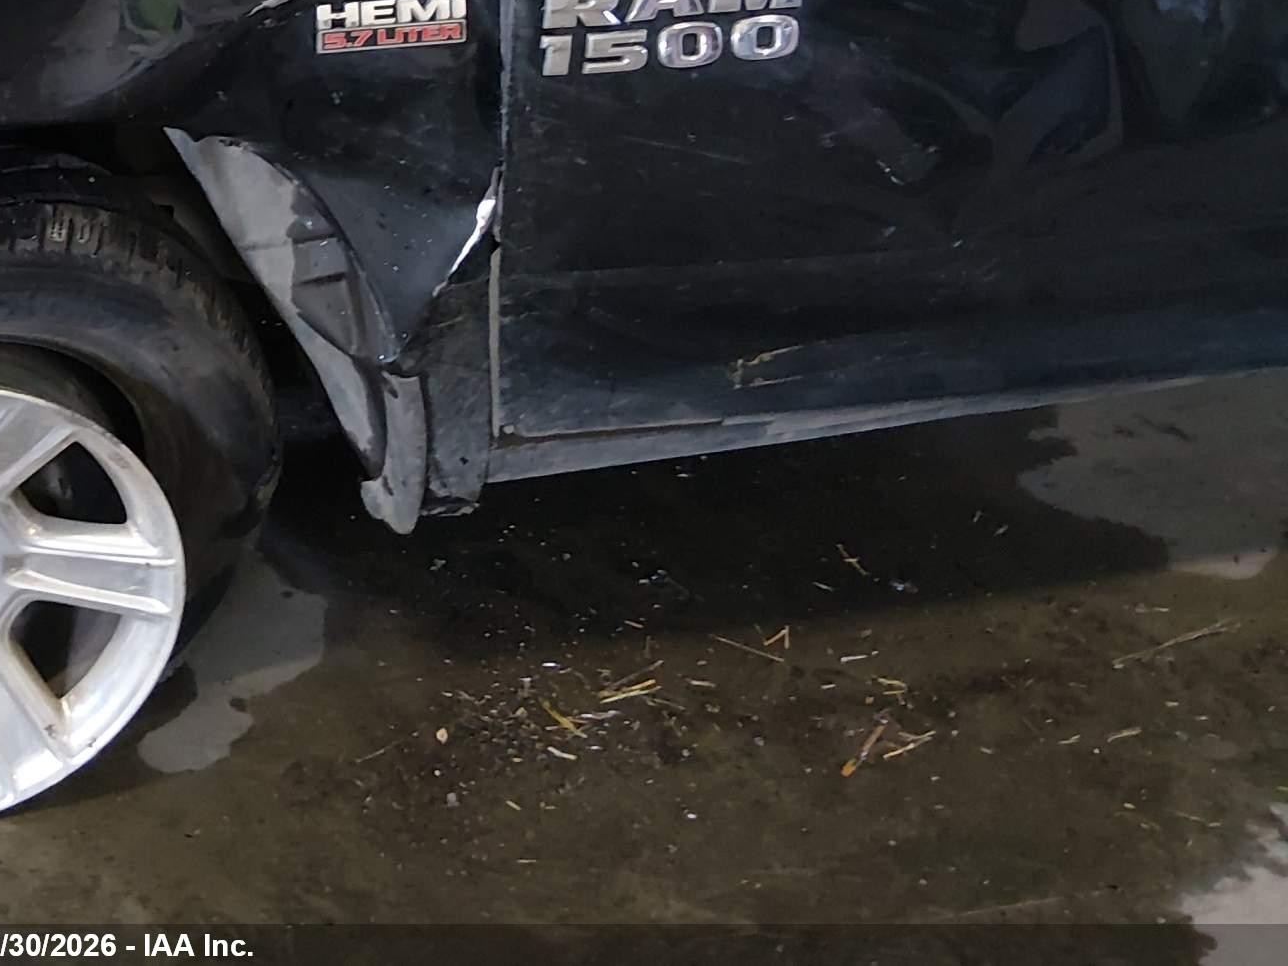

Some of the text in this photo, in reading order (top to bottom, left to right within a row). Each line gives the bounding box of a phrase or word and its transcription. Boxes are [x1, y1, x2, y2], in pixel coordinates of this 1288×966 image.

[321, 22, 463, 51] 5.7 LITER
[540, 14, 801, 77] 1500
